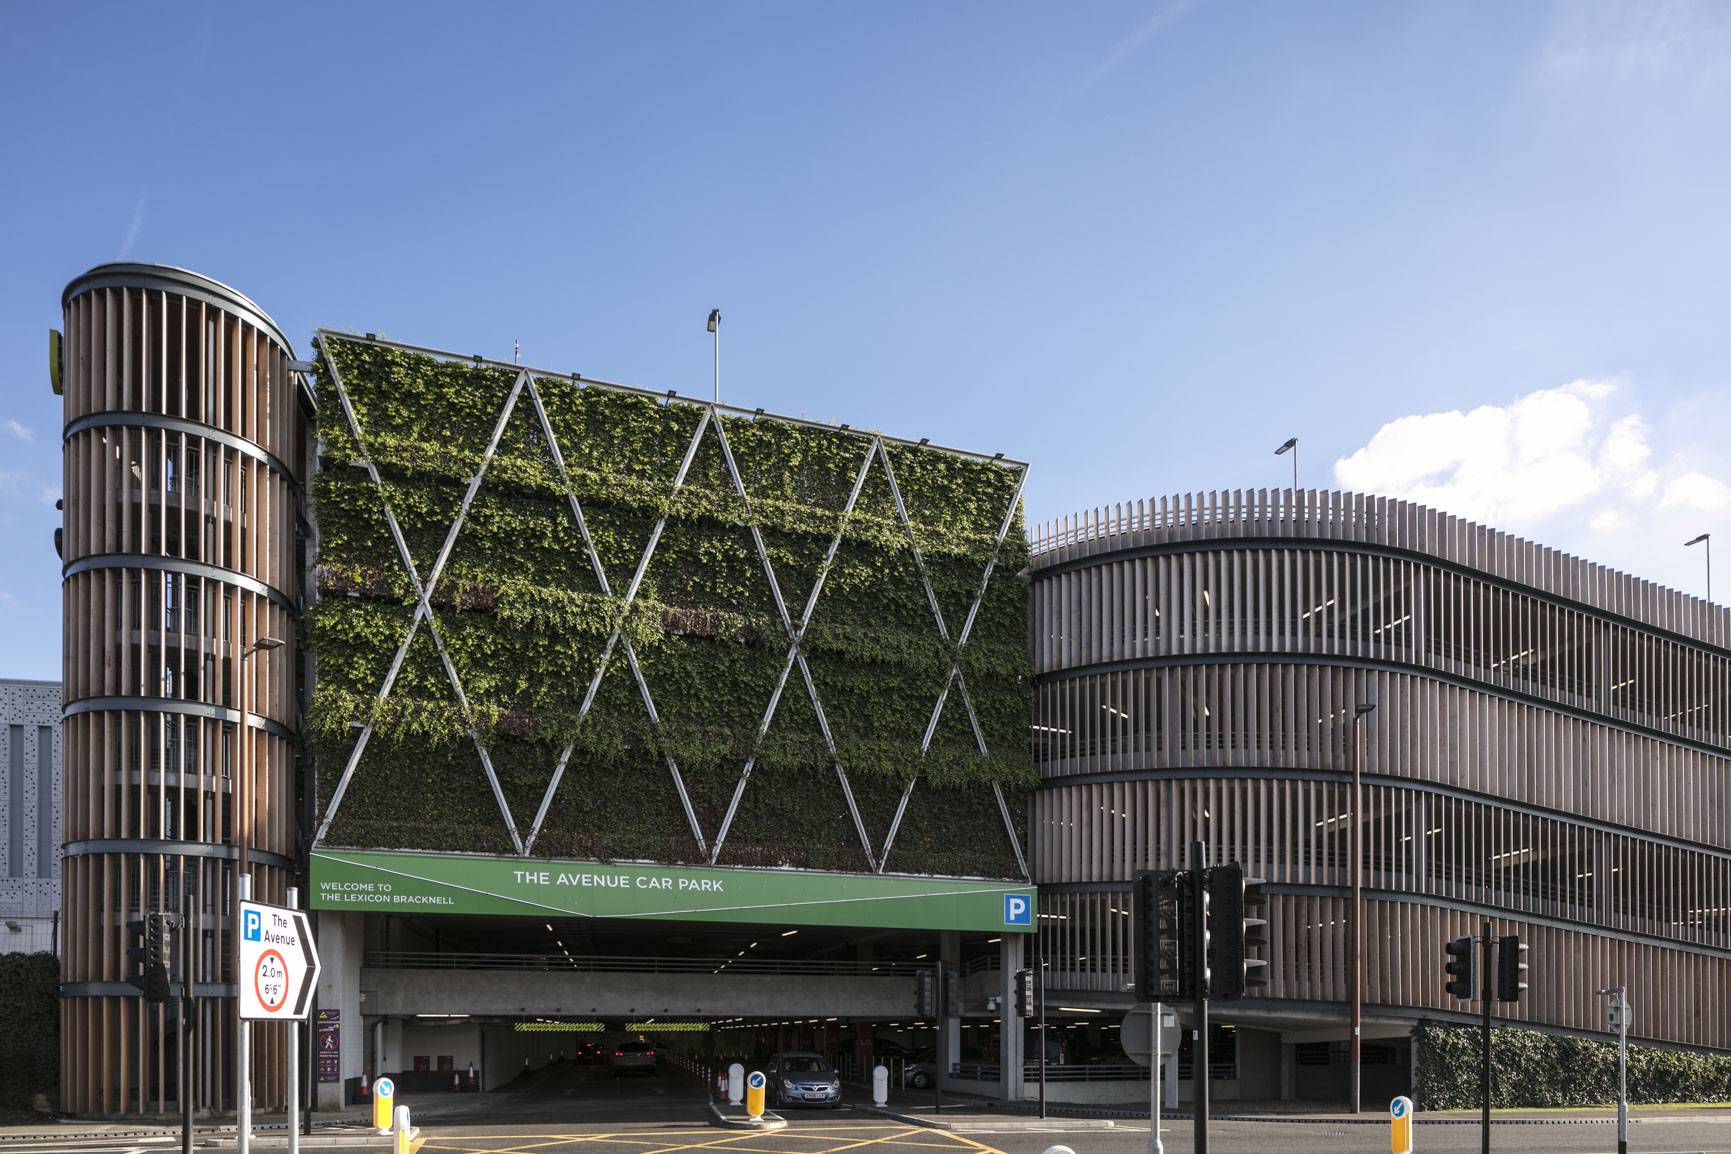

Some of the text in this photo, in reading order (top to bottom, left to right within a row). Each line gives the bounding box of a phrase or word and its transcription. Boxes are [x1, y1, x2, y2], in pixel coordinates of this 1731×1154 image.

[320, 882, 392, 892] WELCOME TO
[513, 871, 724, 892] THE AVENUE CAR PARK
[320, 893, 455, 905] THE LEXICON BRACKNELL
[1009, 898, 1026, 921] P
[247, 912, 260, 939] P
[272, 913, 288, 929] The
[263, 930, 296, 946] Avenue
